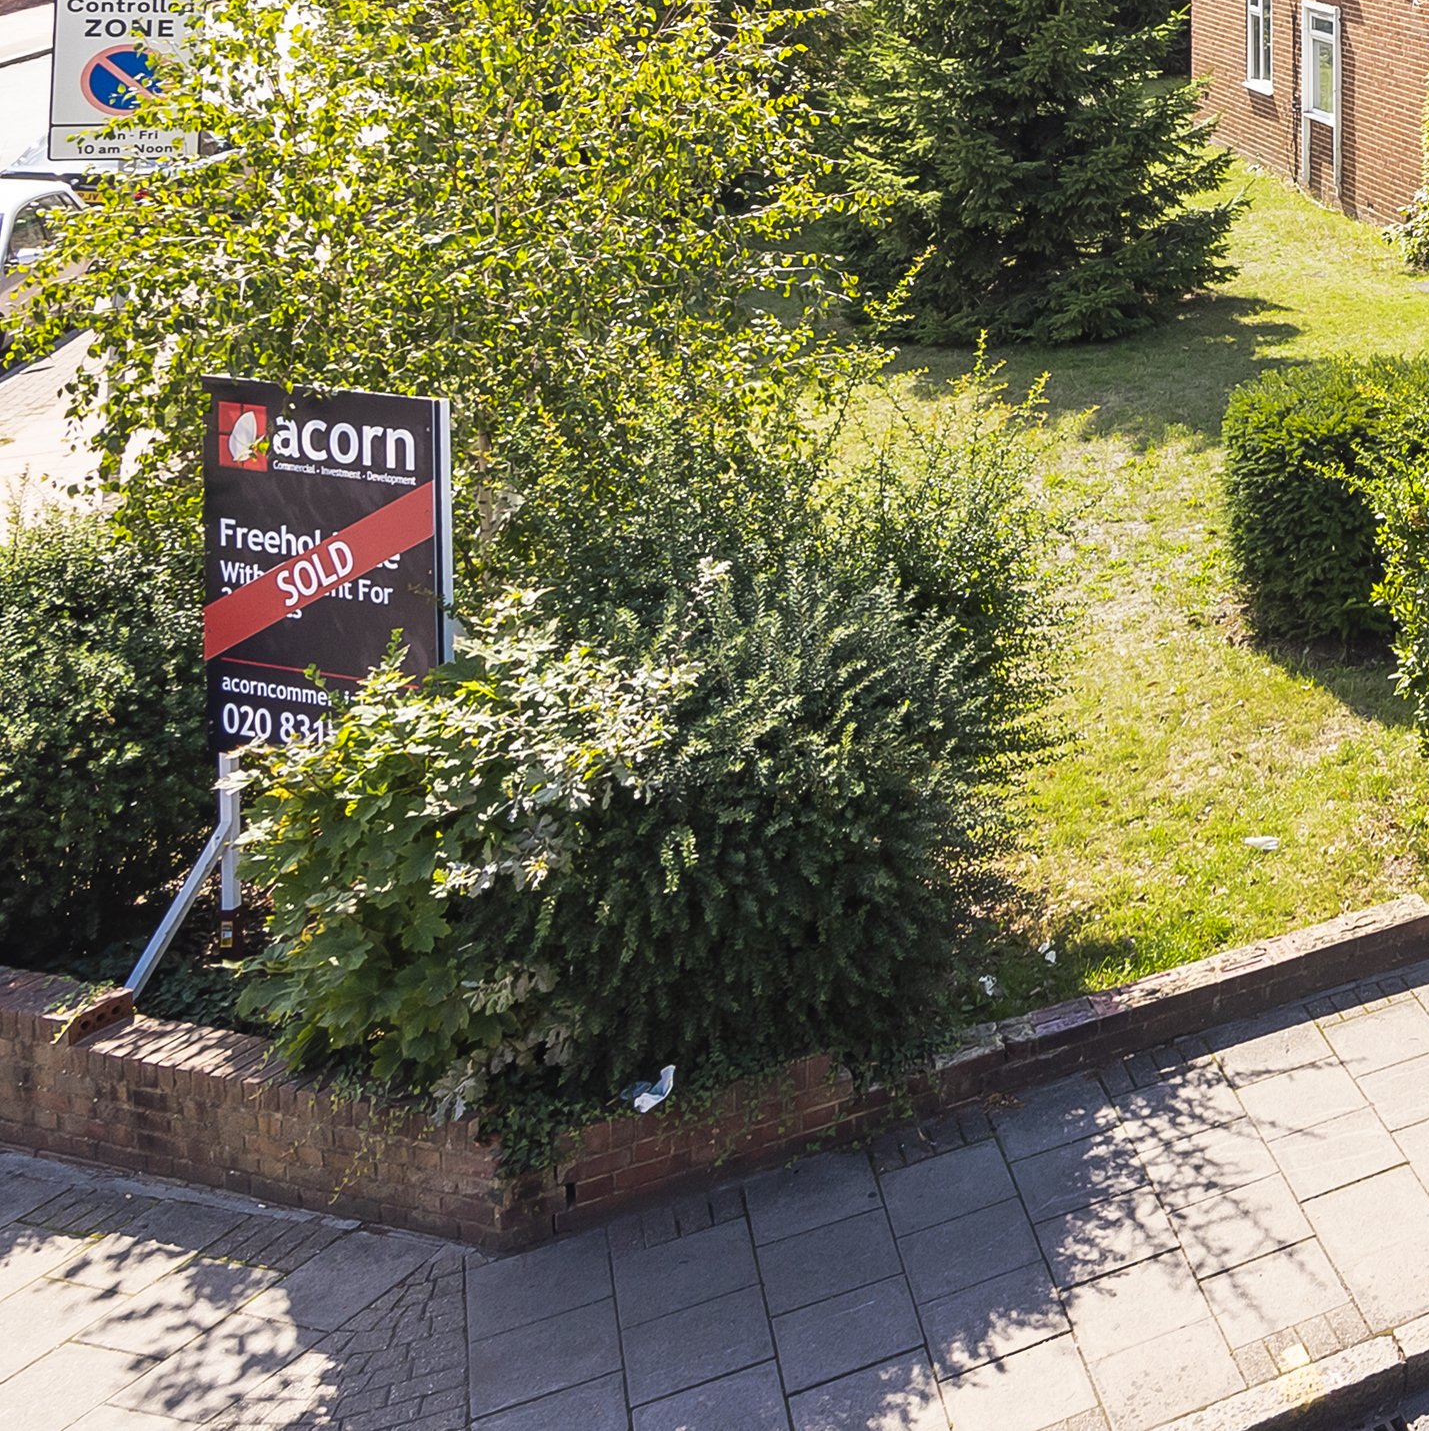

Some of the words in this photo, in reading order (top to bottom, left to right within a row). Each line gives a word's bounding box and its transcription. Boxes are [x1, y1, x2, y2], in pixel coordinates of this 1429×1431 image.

[84, 19, 174, 37] ZONE
[78, 144, 95, 154] 10
[98, 145, 120, 154] am
[134, 144, 173, 154] Noon
[139, 130, 158, 139] Fri
[272, 416, 416, 471] acorn
[272, 459, 316, 474] Commercial
[320, 465, 362, 480] Investment
[366, 470, 417, 486] Development
[220, 518, 338, 556] Freehol
[276, 541, 354, 607] SOLD
[358, 579, 394, 604] For
[222, 676, 364, 707] acorncommei
[222, 702, 272, 740] 020
[280, 711, 334, 746] 831
